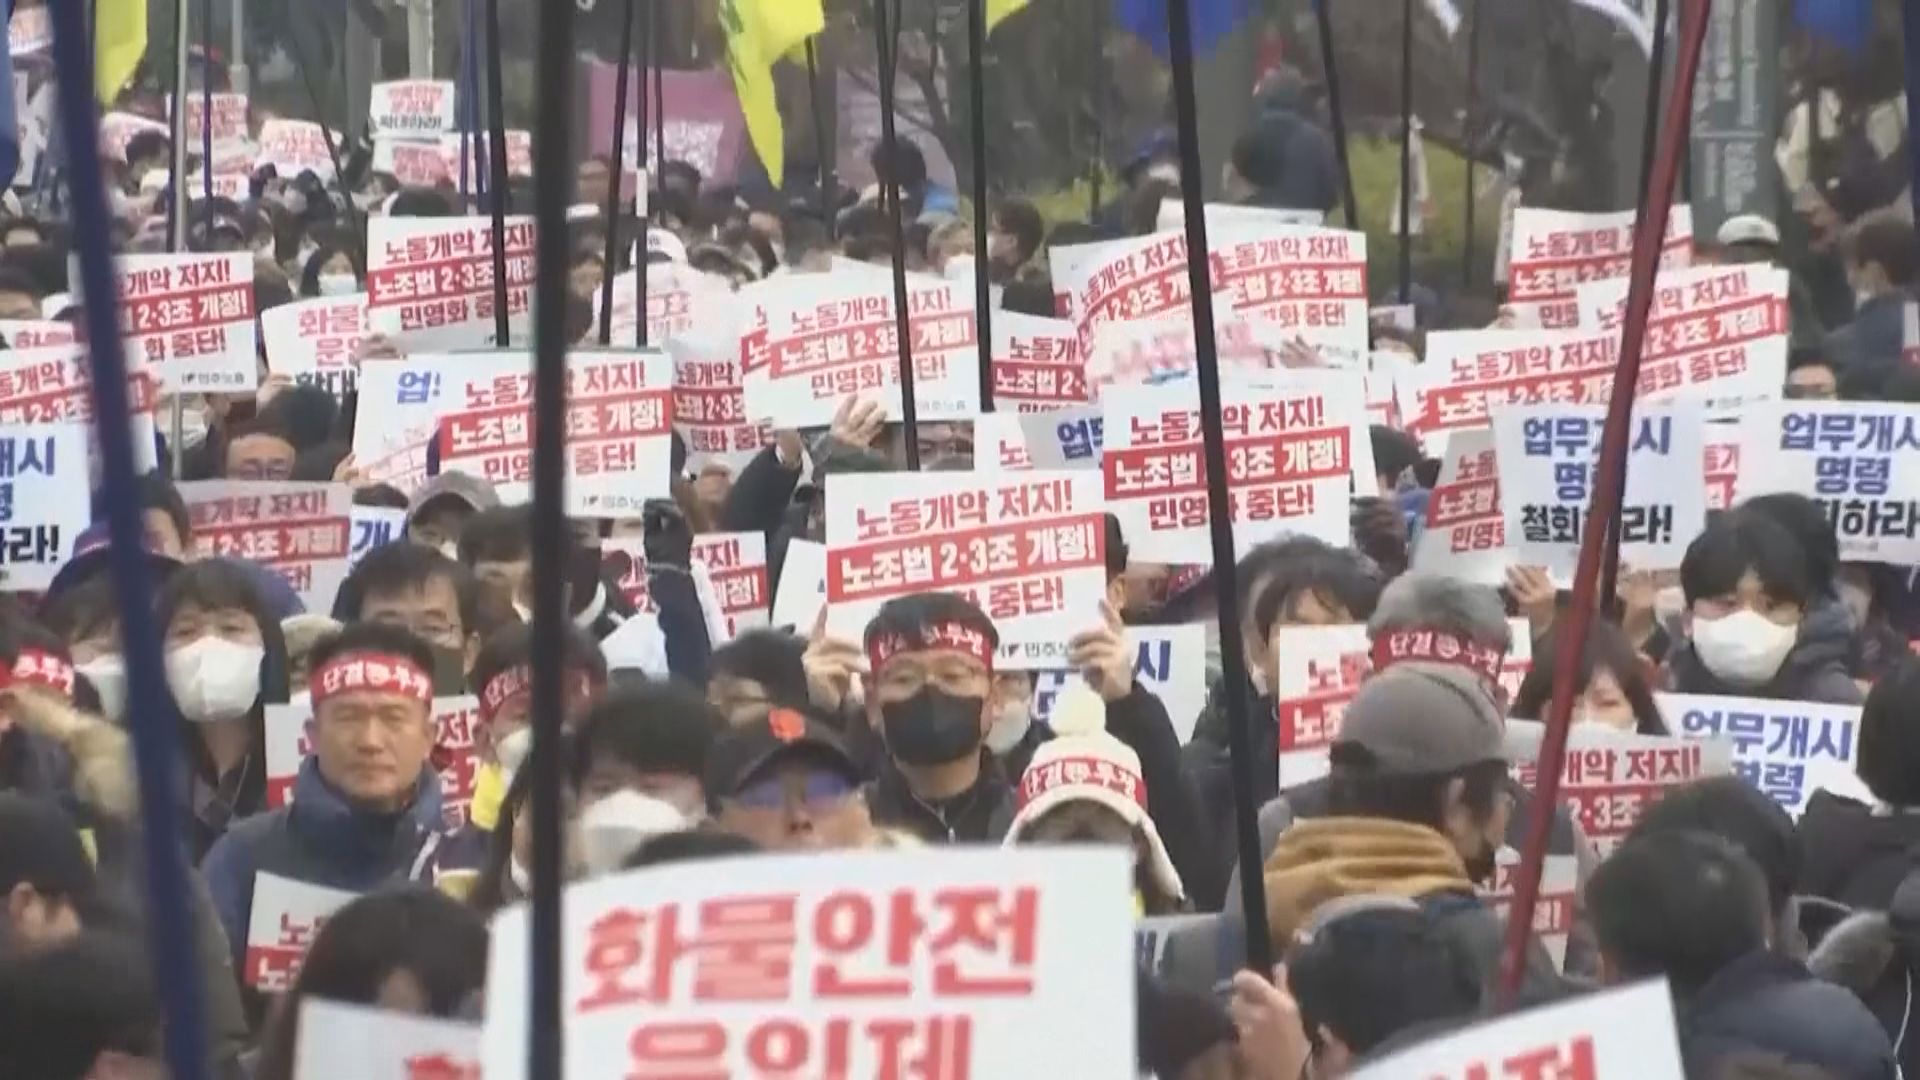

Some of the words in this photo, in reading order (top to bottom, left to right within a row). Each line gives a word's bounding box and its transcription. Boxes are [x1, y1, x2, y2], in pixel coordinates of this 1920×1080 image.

[385, 230, 475, 265] 노동개악
[178, 259, 231, 287] 저지!
[374, 269, 436, 300] 노조법
[1692, 271, 1749, 307] 저지!
[199, 289, 248, 321] 개정!
[298, 303, 369, 337] 화물
[400, 298, 468, 331] 민영화
[791, 296, 888, 334] 노동개악
[171, 328, 226, 359] 중단!
[780, 329, 849, 365] 노조법
[1010, 335, 1080, 362] 노동개
[1451, 346, 1551, 383] 노동개악
[1559, 336, 1617, 369] 저지!
[583, 360, 645, 393] 저지!
[811, 363, 883, 399] 민영화
[1690, 347, 1747, 383] 중단!
[397, 370, 441, 404] 업!
[450, 410, 530, 448] 노조법
[605, 396, 665, 434] 개정!
[1258, 395, 1325, 431] 저지!
[1523, 415, 1672, 456] 업무시
[575, 442, 636, 476] 중단!
[1115, 451, 1198, 492] 노조법
[1281, 435, 1343, 473] 개정!
[1815, 456, 1892, 496] 명령
[856, 489, 990, 541] 노동개악
[997, 478, 1073, 517] 저지!
[1246, 483, 1315, 521] 중단!
[1521, 503, 1673, 544] 철회라!
[841, 544, 934, 594] 노조법
[939, 532, 1019, 579] 2·3조
[1026, 520, 1097, 564] 개정!
[989, 575, 1065, 619] 중단!
[1626, 746, 1700, 782] 저지!
[575, 885, 1040, 1013] 화물안전
